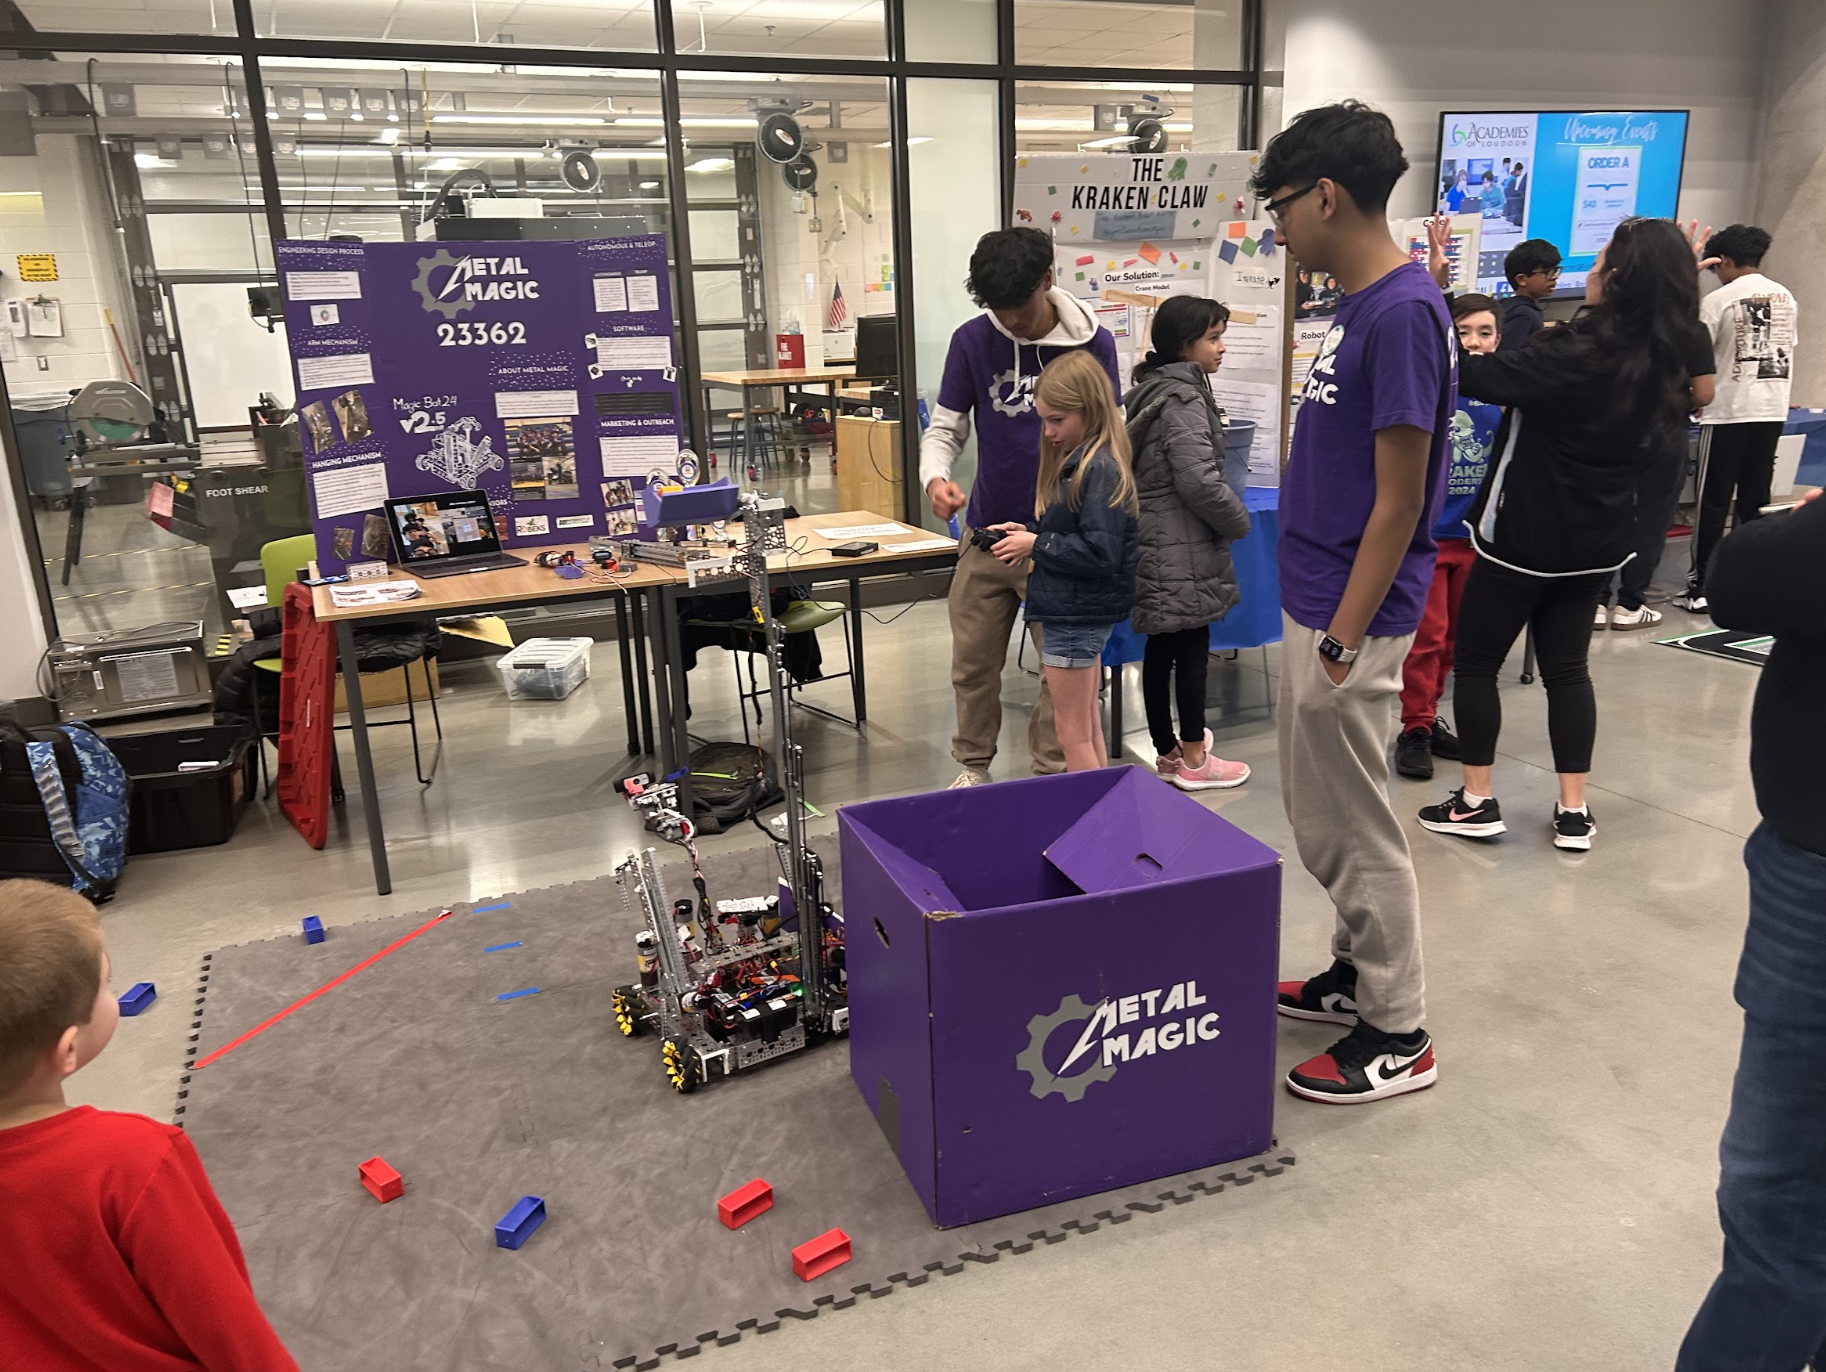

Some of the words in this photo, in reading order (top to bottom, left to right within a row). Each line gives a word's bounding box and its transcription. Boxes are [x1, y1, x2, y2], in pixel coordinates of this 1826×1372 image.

[1467, 122, 1529, 142] ACADEMIES
[1132, 158, 1164, 182] THE
[1588, 157, 1620, 169] ORDER
[1622, 156, 1629, 168] A
[1071, 185, 1150, 210] KRAKEN
[1158, 185, 1209, 209] CLAW
[278, 246, 316, 254] ENGINEERING
[317, 247, 338, 255] DESIGN
[587, 242, 628, 251] AUTONOMOUS
[1105, 274, 1121, 282] Our
[1123, 271, 1159, 281] Solution:
[464, 281, 540, 301] MAGIC
[436, 321, 527, 346] 23362
[612, 324, 645, 332] SOFTWARE
[393, 398, 421, 413] Magic
[600, 419, 636, 427] MARKETING
[643, 418, 675, 426] OUTREACH
[312, 458, 342, 469] HANGING
[342, 452, 382, 464] MECHANISM
[205, 488, 233, 498] FOOT
[234, 485, 269, 495] SHEAR
[1103, 1012, 1221, 1067] MAGIC
